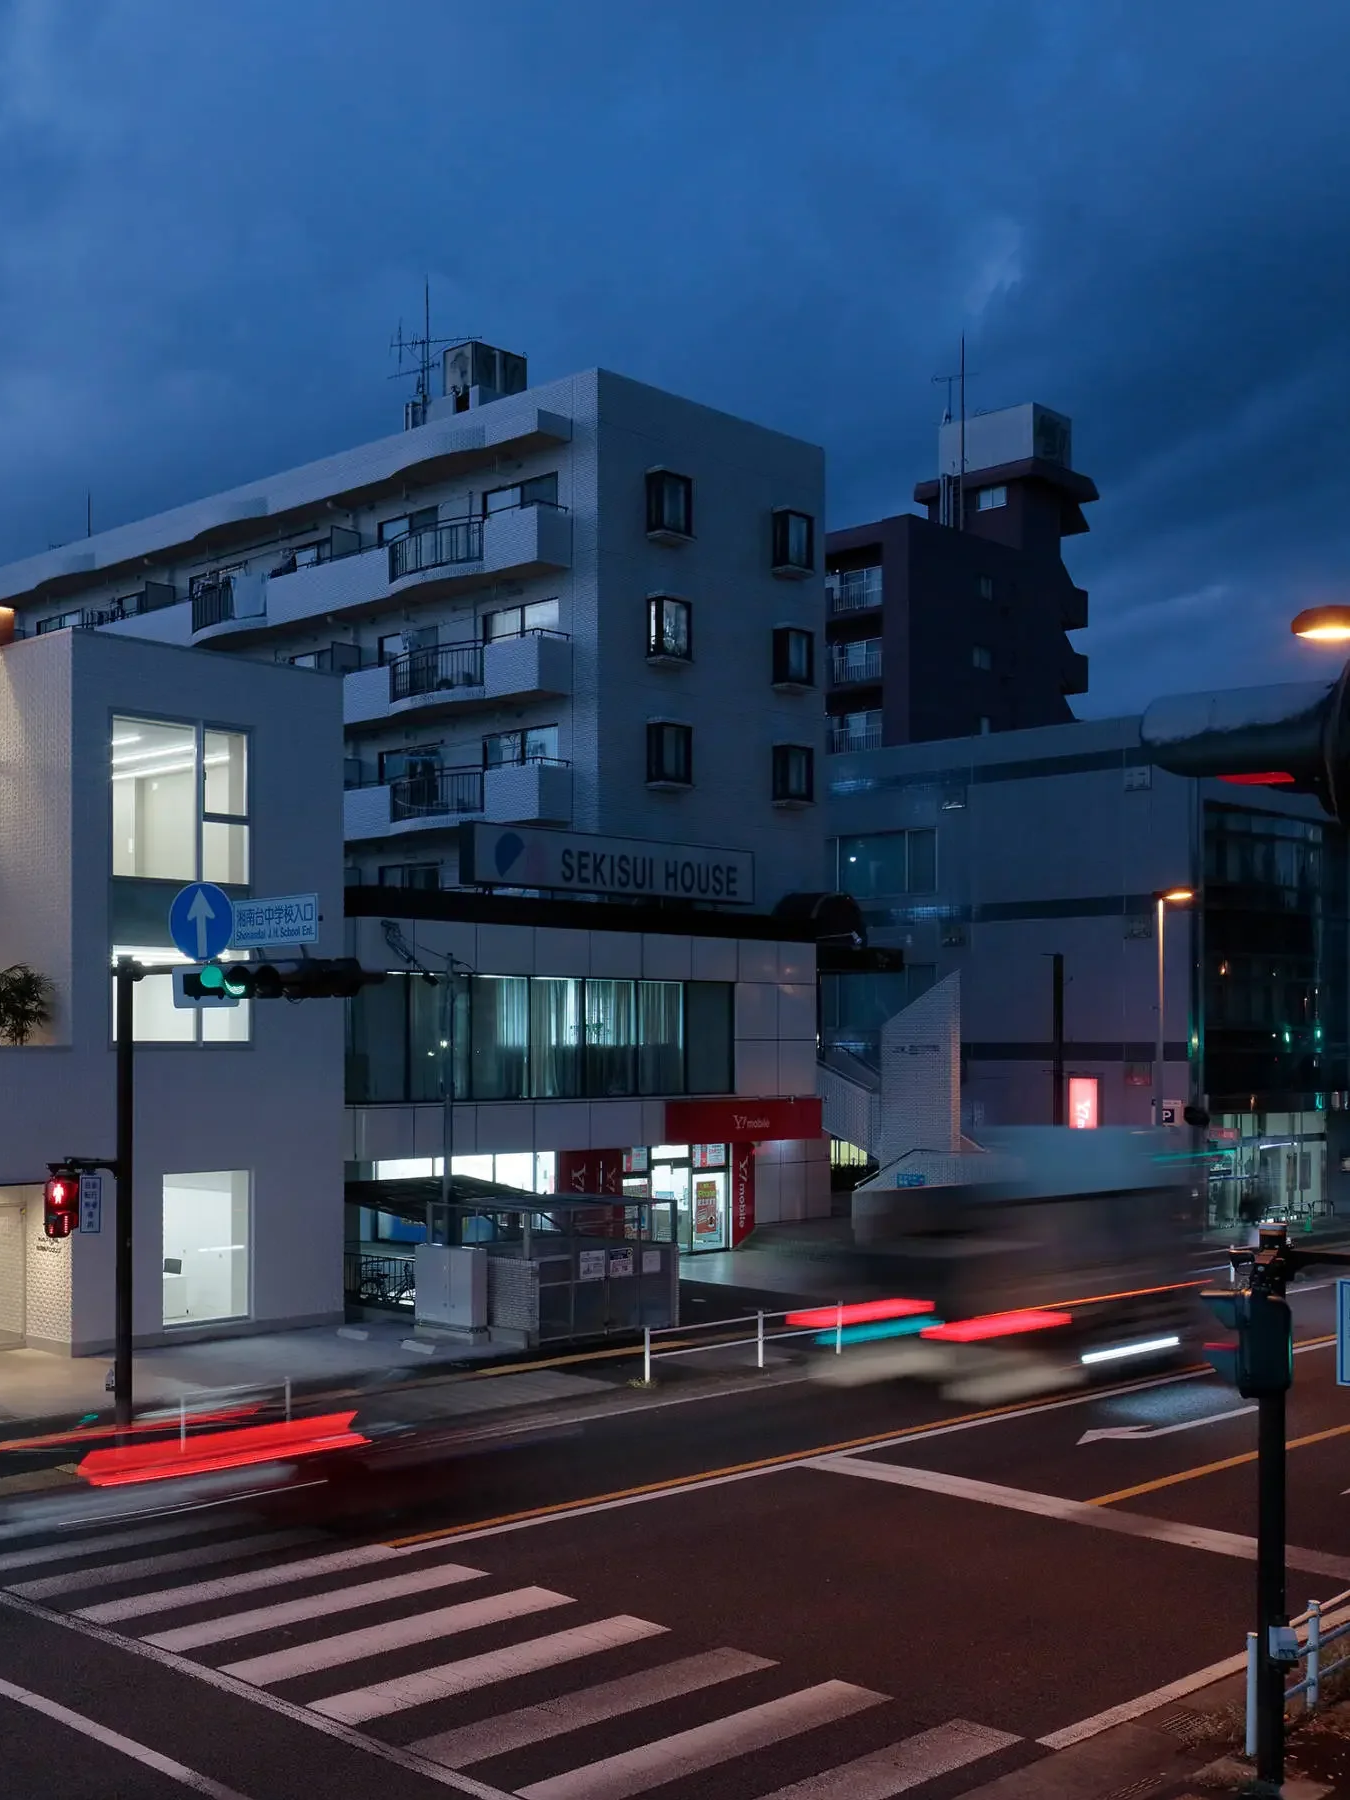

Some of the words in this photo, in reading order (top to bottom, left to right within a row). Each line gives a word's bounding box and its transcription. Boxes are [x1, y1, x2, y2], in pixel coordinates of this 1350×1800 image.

[561, 848, 653, 890] SEKISUI
[664, 859, 738, 897] HOUSE
[236, 903, 314, 928] 湘南台中学校入口
[1161, 1110, 1172, 1122] P
